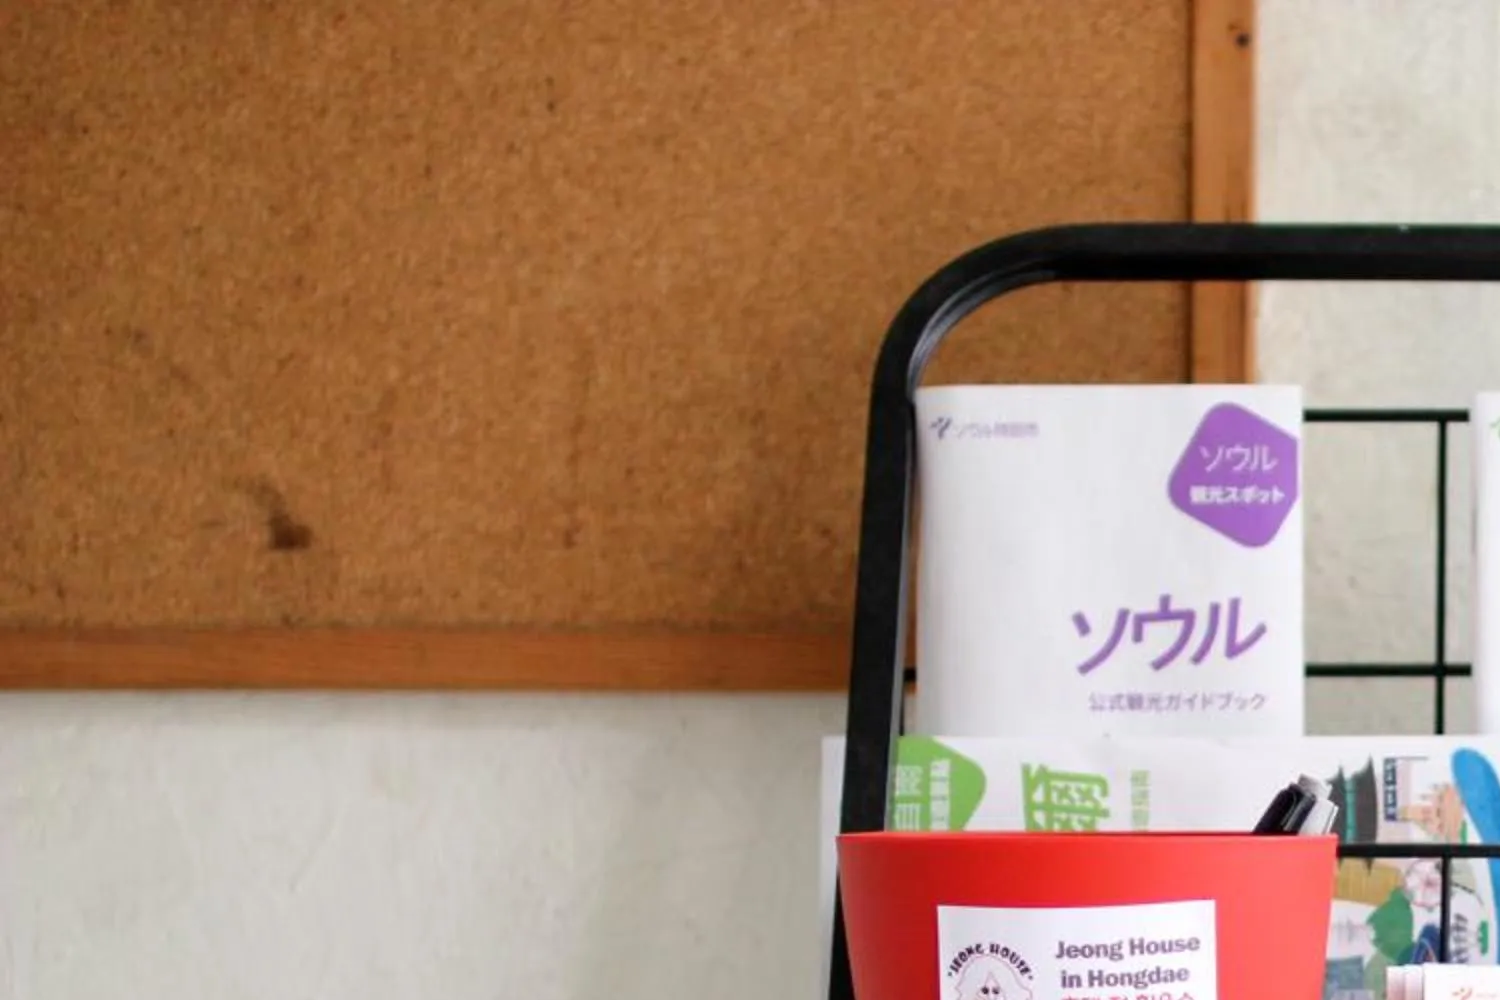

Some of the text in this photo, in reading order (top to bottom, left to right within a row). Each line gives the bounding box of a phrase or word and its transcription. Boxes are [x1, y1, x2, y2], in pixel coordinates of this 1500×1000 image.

[1200, 444, 1278, 474] ソウル
[1072, 594, 1267, 675] ソウル
[1055, 936, 1201, 961] Jeong House
[1061, 965, 1190, 990] in Hongdae
